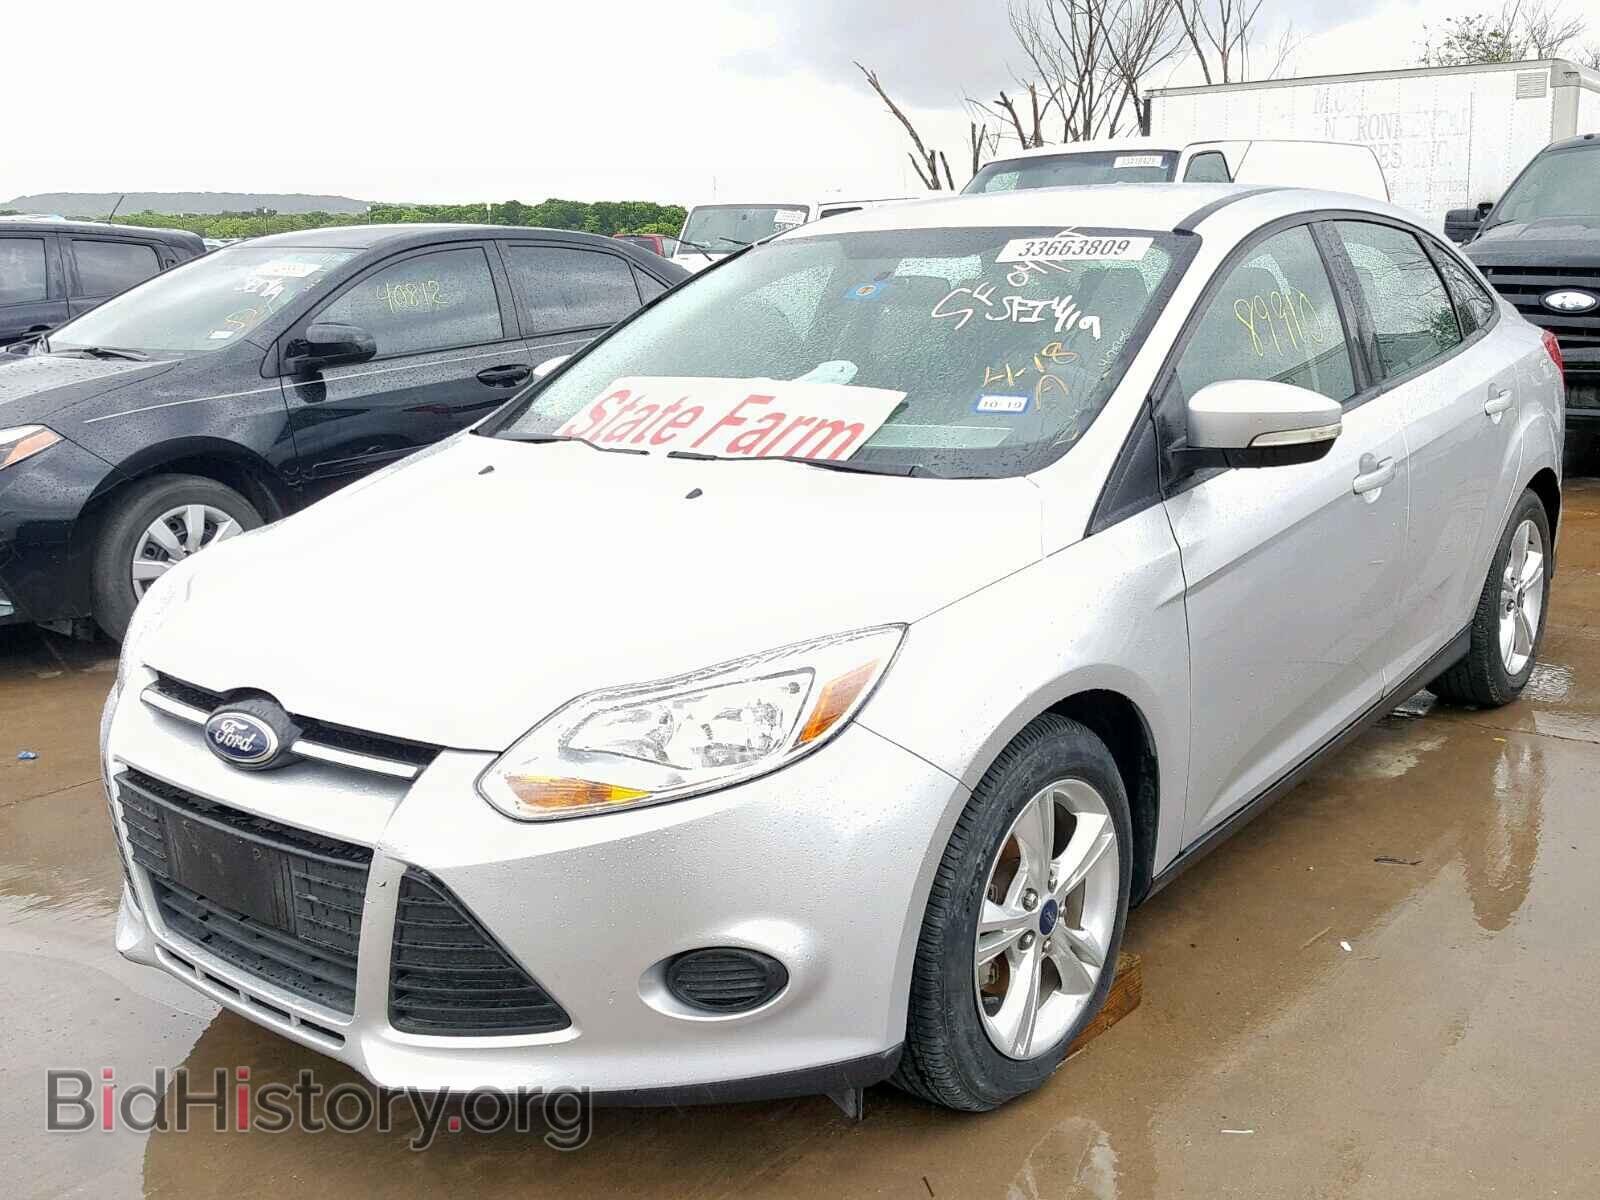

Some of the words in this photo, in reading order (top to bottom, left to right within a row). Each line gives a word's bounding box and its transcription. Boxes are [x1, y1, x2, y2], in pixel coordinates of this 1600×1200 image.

[1018, 239, 1130, 257] 33663809
[566, 389, 704, 445] State
[690, 394, 866, 459] Farm
[215, 719, 257, 752] Ford
